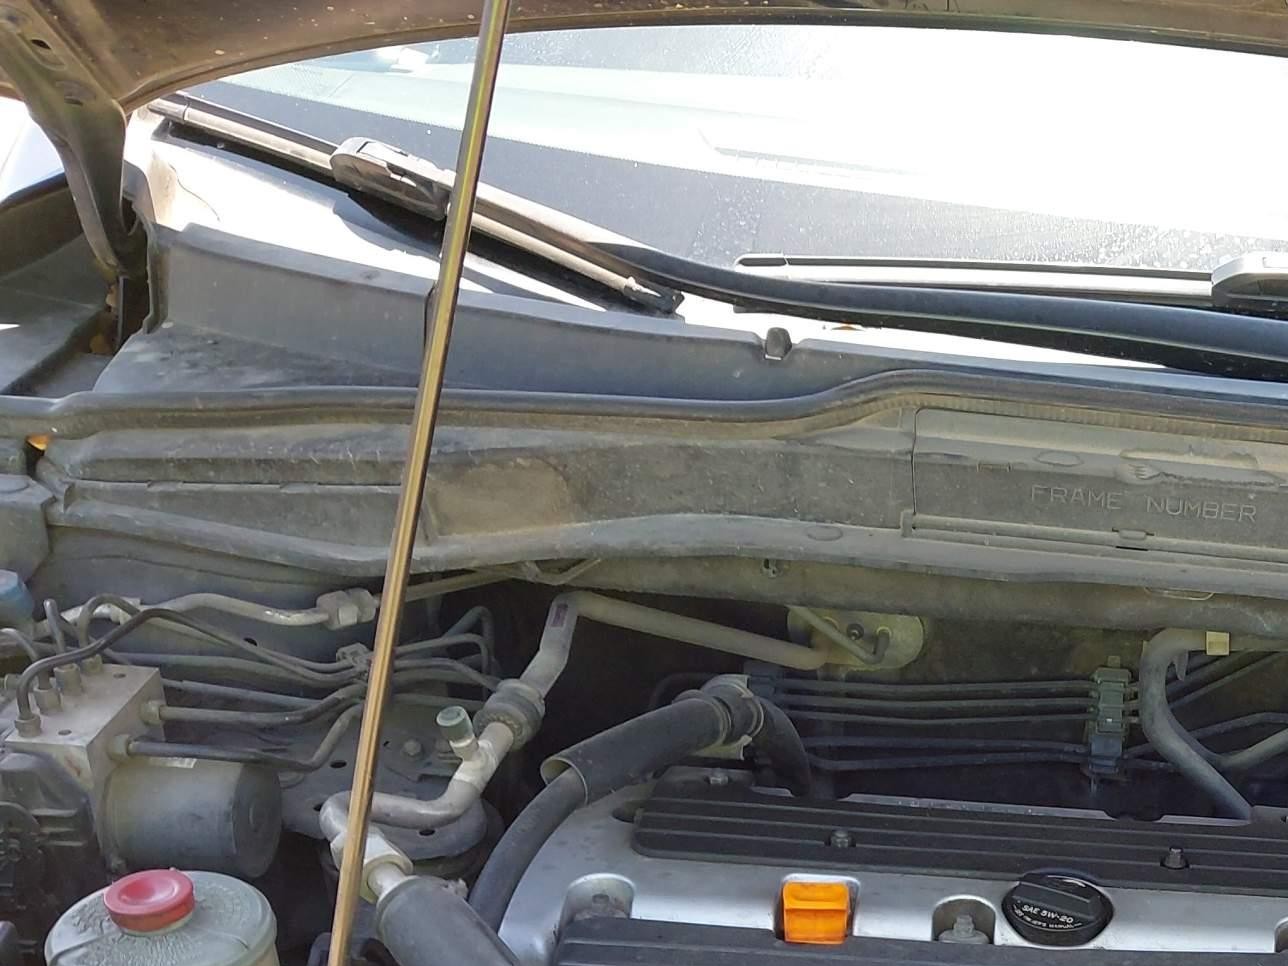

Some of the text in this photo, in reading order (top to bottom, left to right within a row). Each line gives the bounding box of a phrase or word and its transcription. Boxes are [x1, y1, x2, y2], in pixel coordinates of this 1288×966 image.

[1031, 484, 1257, 523] FRAME NUMBER
[1022, 904, 1041, 915] SAE
[1040, 910, 1074, 924] 5W-20
